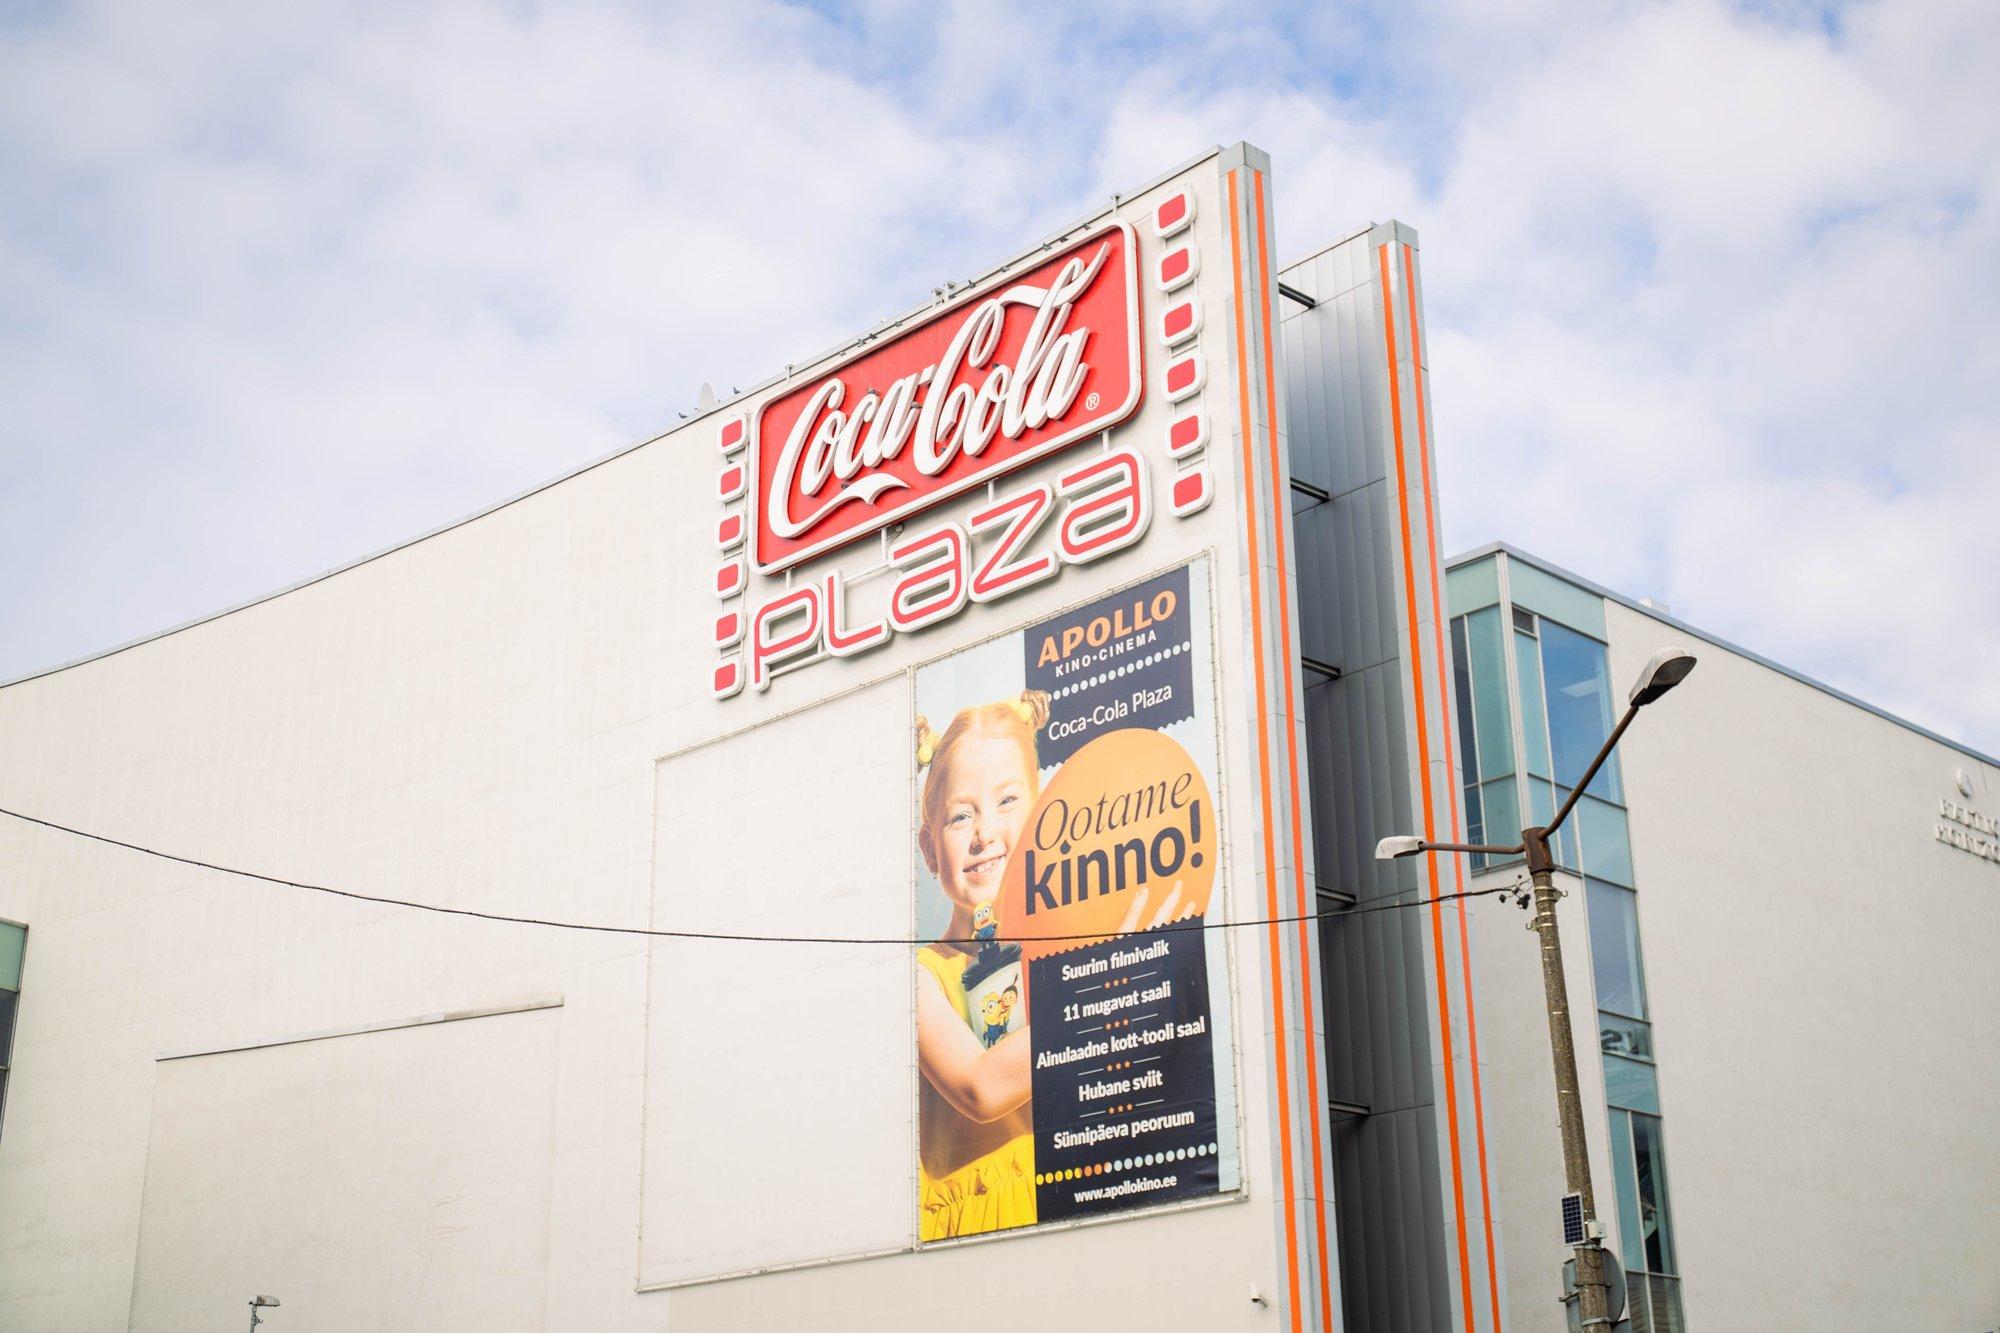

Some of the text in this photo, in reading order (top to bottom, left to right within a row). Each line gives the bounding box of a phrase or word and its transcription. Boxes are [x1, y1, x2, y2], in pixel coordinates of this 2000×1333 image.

[767, 240, 1112, 539] Coca-Cola
[1037, 590, 1176, 668] APOLLO
[1048, 684, 1172, 741] Coca-Cola Plaza
[1034, 772, 1192, 851] Ootame
[1025, 799, 1204, 916] kinno!
[1061, 939, 1170, 981] Suurim filmivalik
[1063, 980, 1172, 1022] 11 mugavat saali
[1036, 1015, 1206, 1070] Ainulaadne kott-tooli saal
[1078, 1070, 1164, 1102] Hubane sviit
[1053, 1110, 1196, 1150] Sünnipäeva peoruum
[1074, 1174, 1178, 1204] www.apollokino.ee
